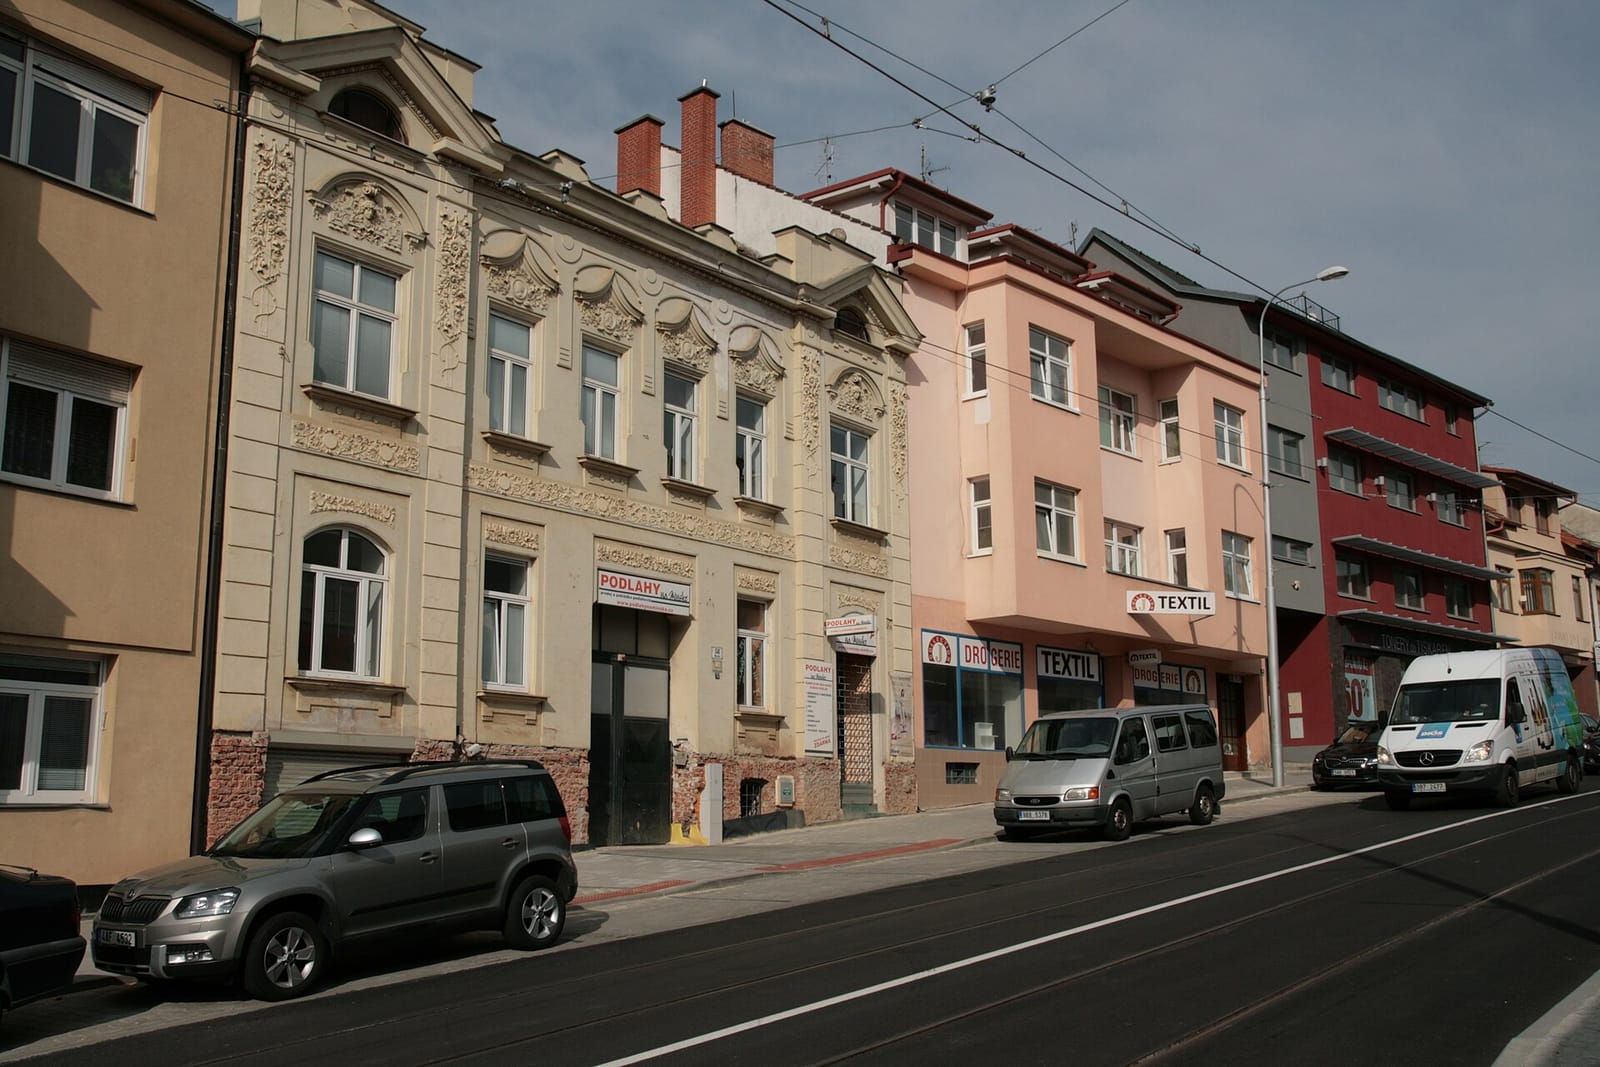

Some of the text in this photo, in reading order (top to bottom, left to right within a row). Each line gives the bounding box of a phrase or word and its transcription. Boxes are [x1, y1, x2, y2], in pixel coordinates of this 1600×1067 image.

[600, 574, 661, 595] PODLAHY
[1158, 595, 1211, 610] TEXTIL
[826, 618, 857, 627] PODLAHY
[964, 644, 1021, 669] DROGERIE
[1040, 650, 1095, 679] TEXTIL
[1134, 668, 1179, 685] DROGERIE
